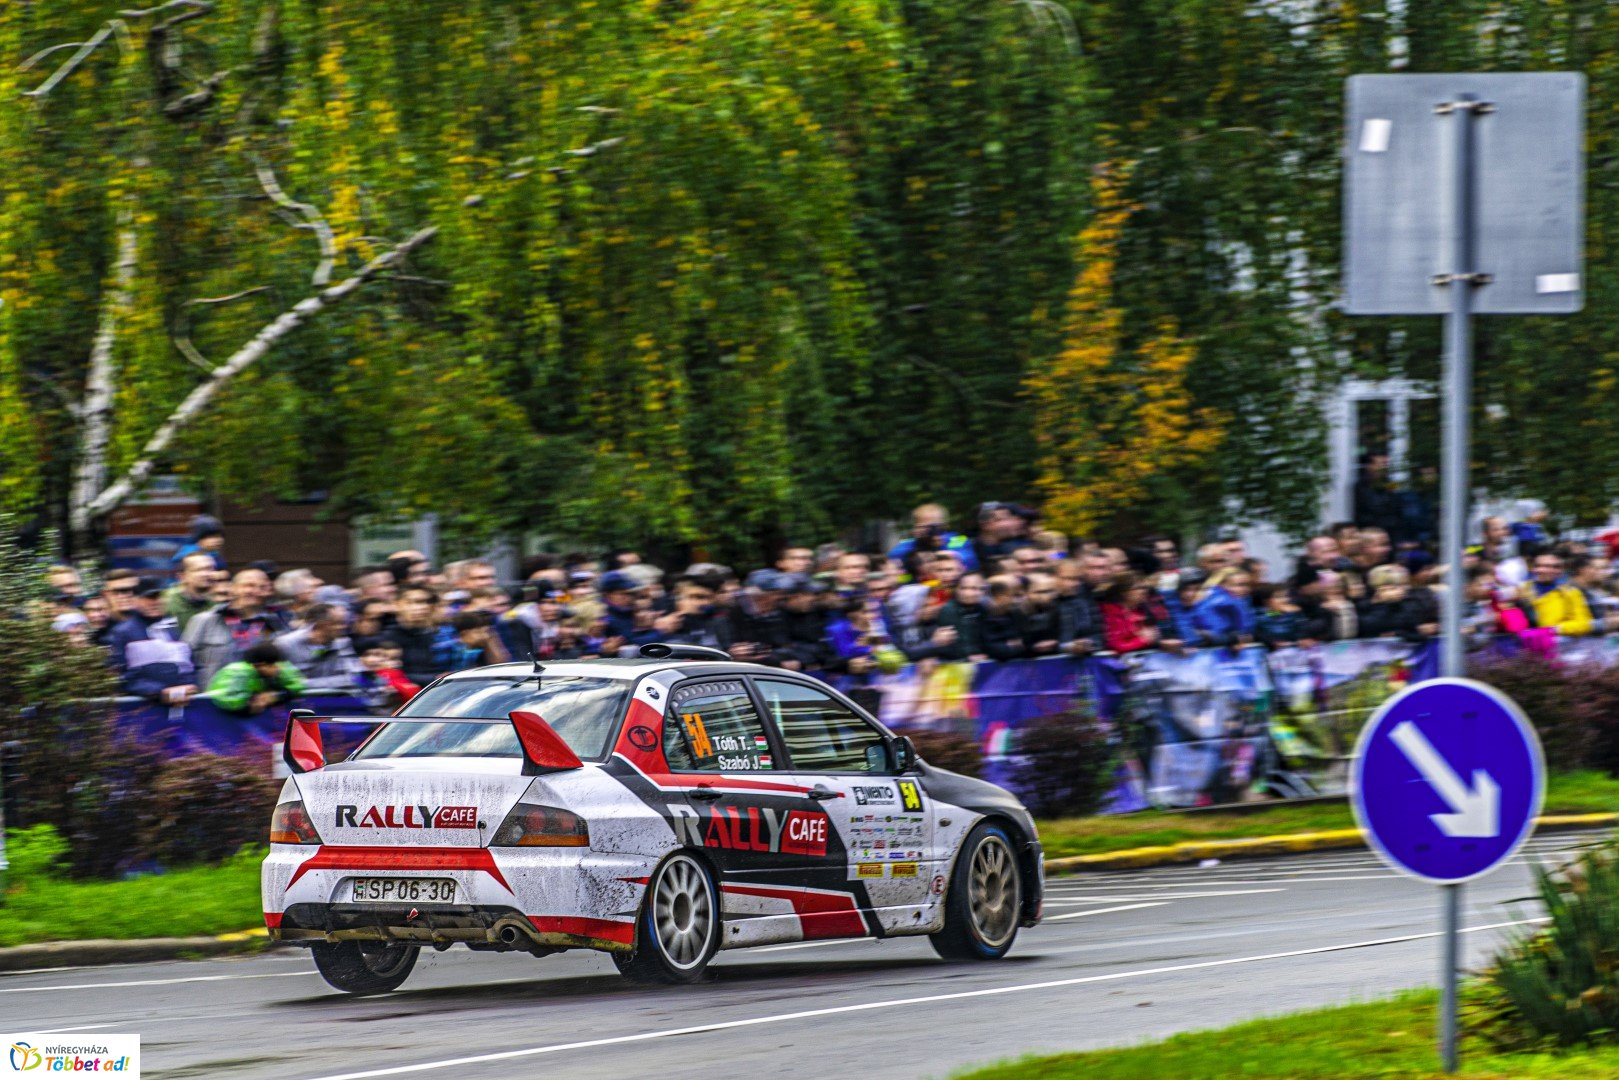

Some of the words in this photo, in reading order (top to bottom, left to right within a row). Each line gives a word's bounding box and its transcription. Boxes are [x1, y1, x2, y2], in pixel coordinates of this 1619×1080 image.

[712, 735, 738, 751] Tóth
[737, 735, 751, 751] T.
[717, 754, 751, 770] Szabó
[335, 804, 440, 829] RALLY
[440, 808, 475, 822] CAFÉ
[666, 803, 789, 853] RALLY
[789, 817, 826, 842] CAFÉ
